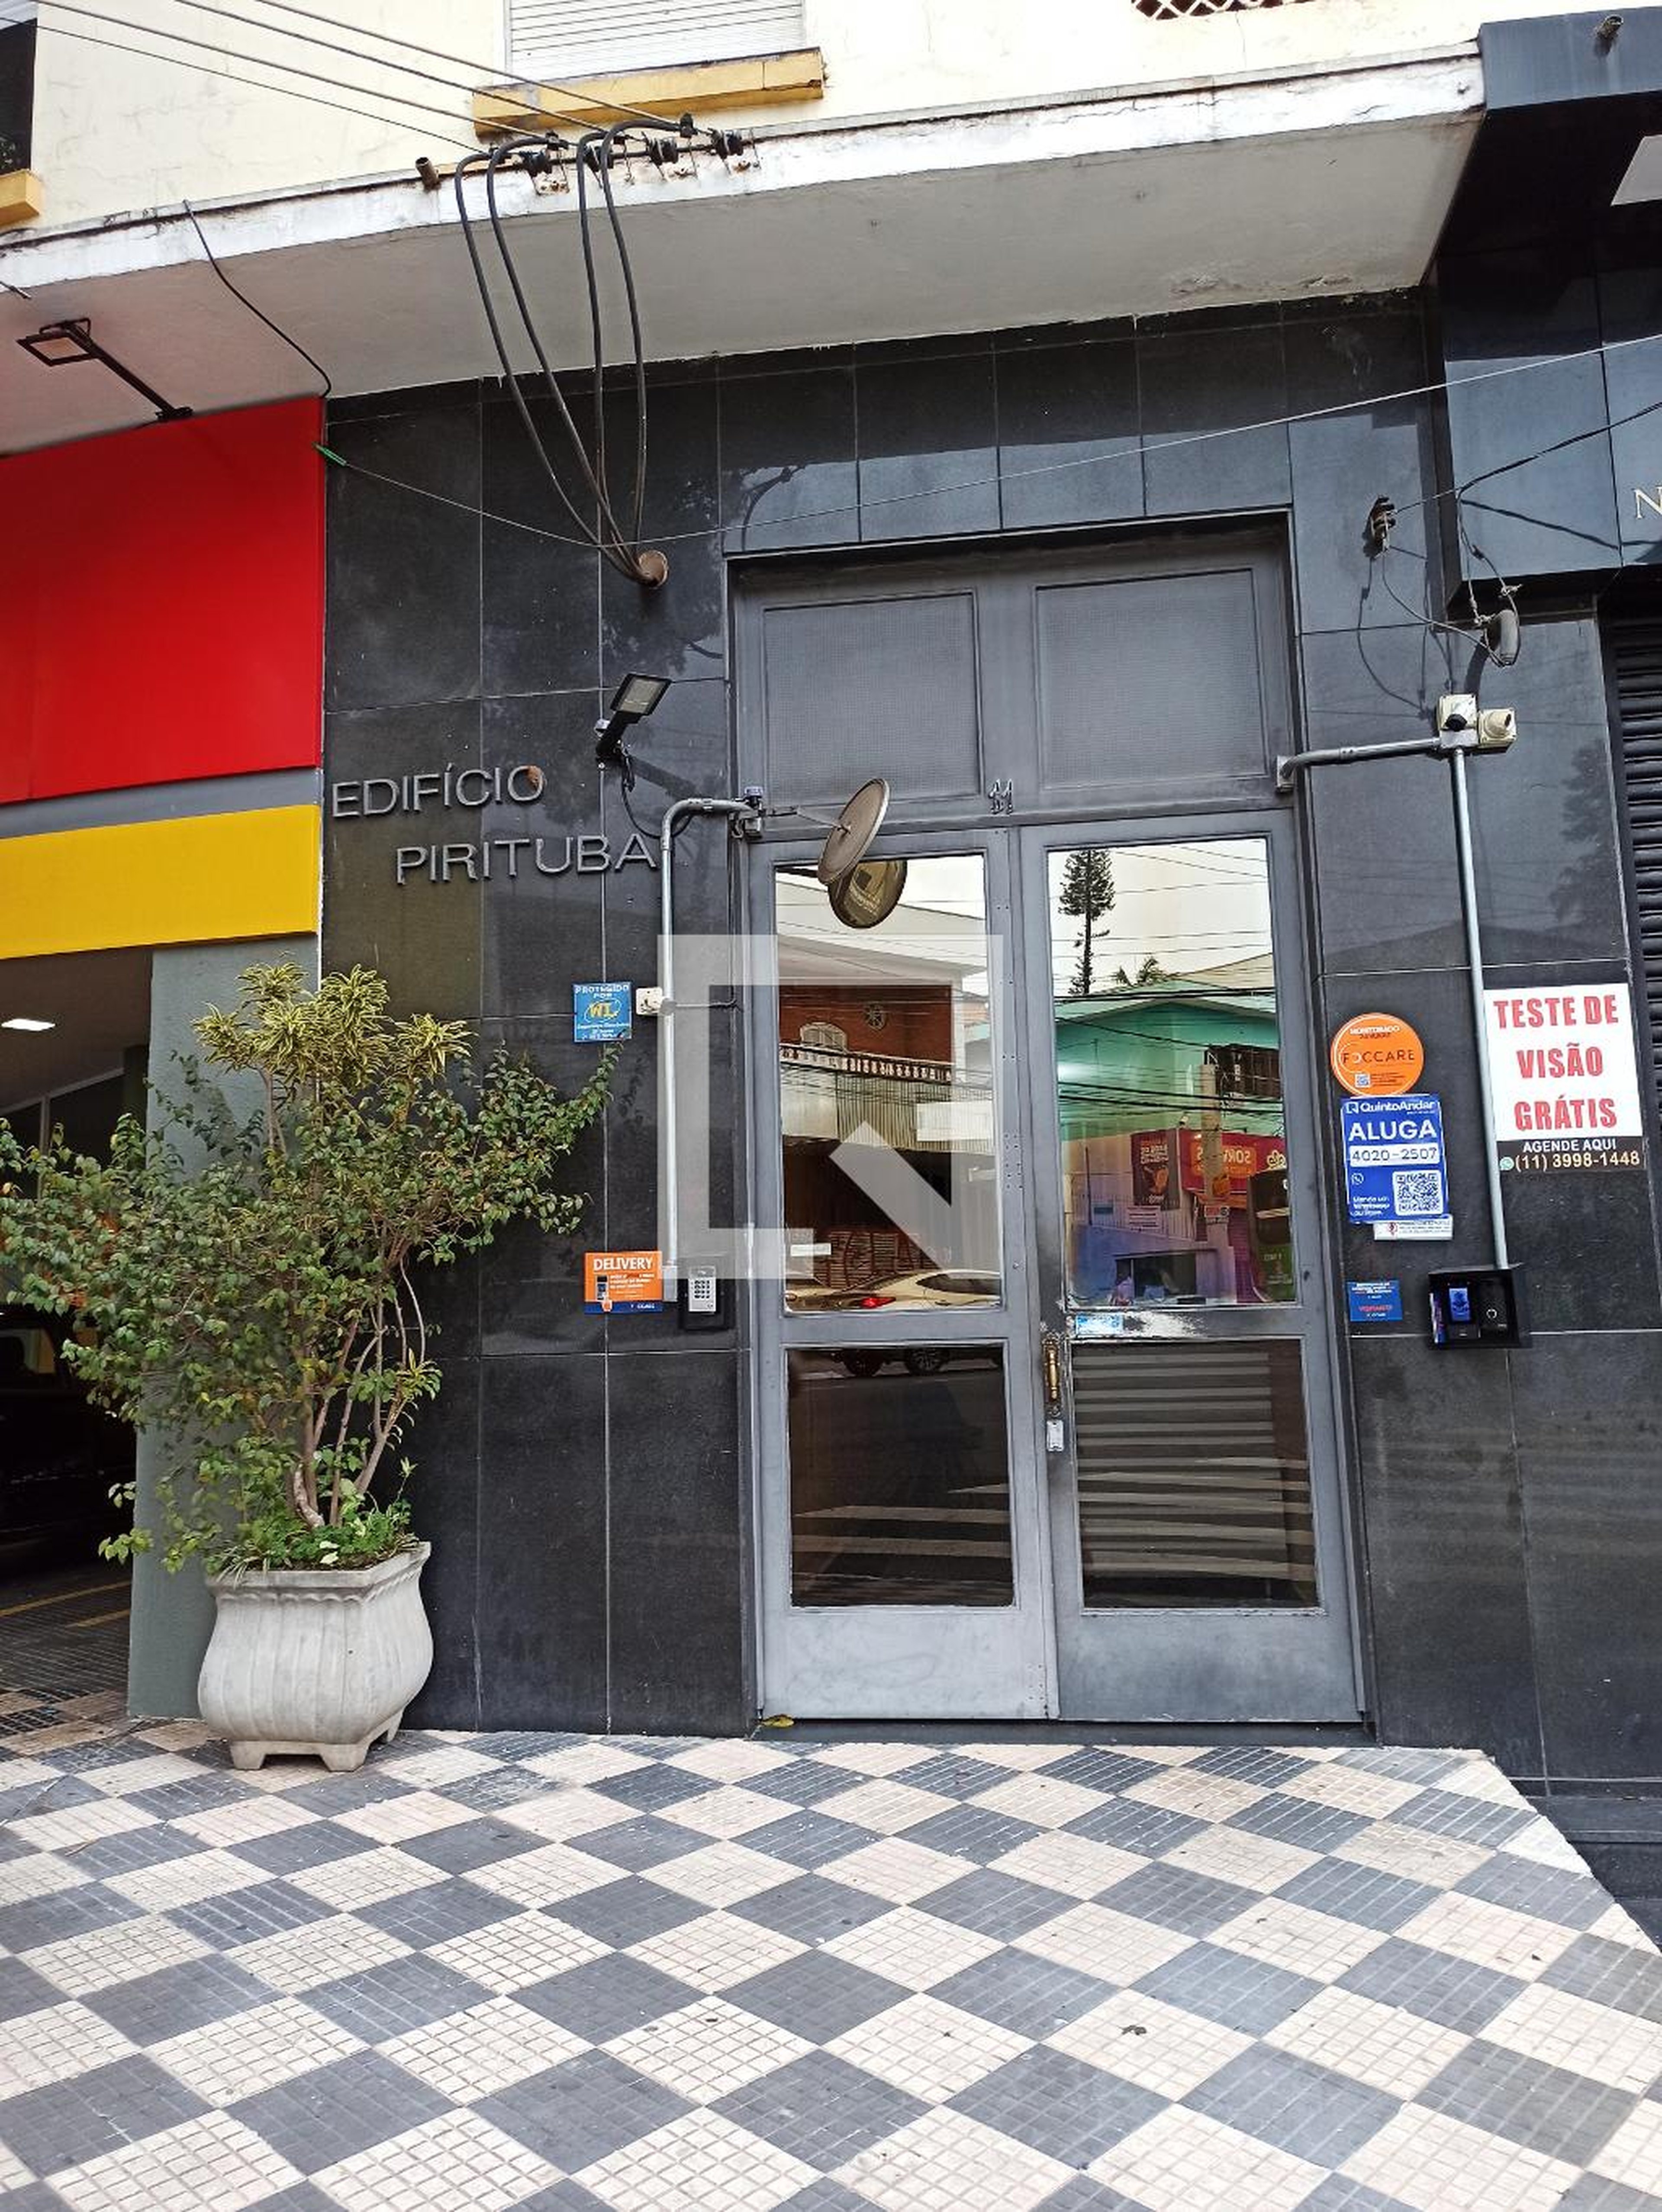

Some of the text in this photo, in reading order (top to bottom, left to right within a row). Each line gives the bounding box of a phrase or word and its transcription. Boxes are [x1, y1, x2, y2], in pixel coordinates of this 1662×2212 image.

[332, 763, 547, 818] EDIFÍCIO
[396, 833, 658, 885] PIRITUBA
[1493, 995, 1619, 1029] TESTE DE
[1516, 1042, 1604, 1079] VISÃO
[1360, 1101, 1435, 1113] QuintoAndar
[1514, 1095, 1617, 1131] GRÁTIS
[1348, 1119, 1437, 1142] ALUGA
[1352, 1147, 1437, 1162] 4020-2507
[1523, 1138, 1617, 1153] AGENDE AQUI
[1515, 1150, 1640, 1172] (11) 3998-1448
[593, 1257, 653, 1270] DELIVERY
